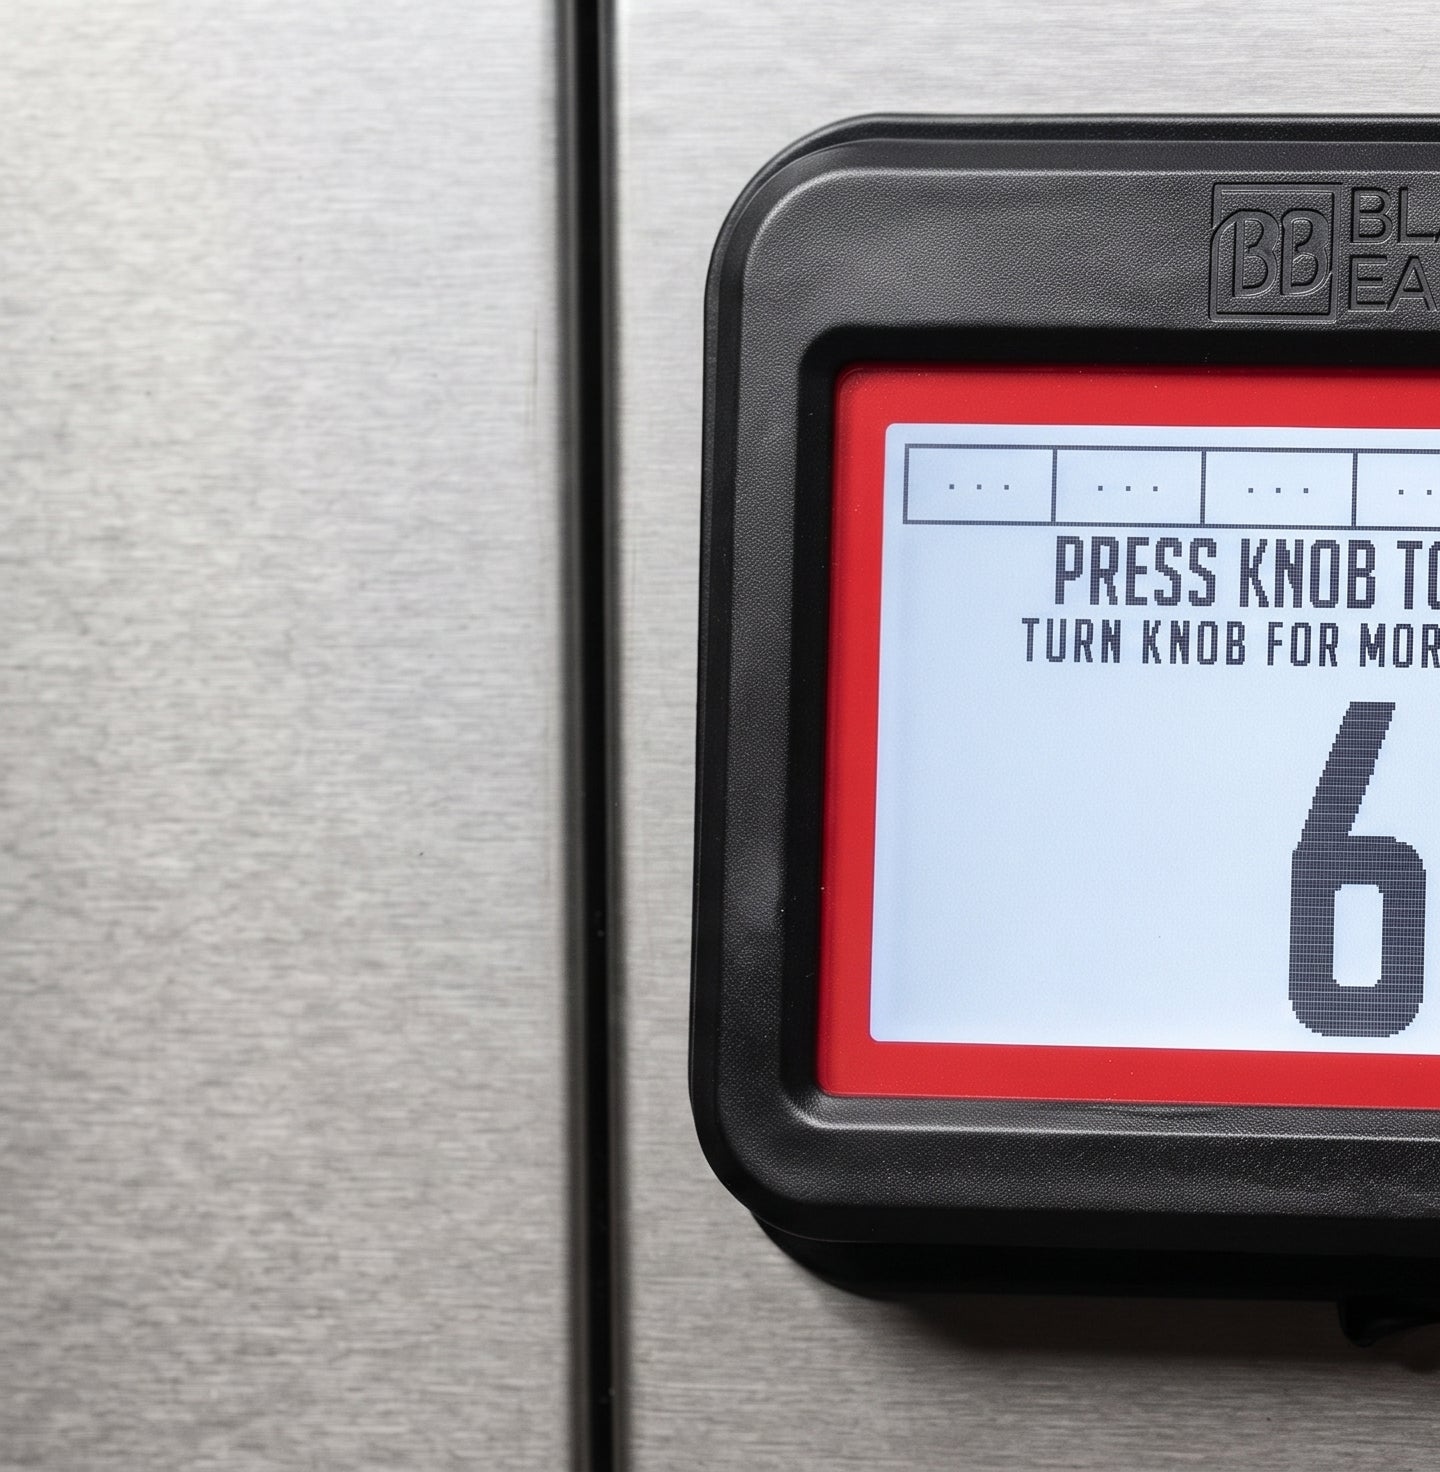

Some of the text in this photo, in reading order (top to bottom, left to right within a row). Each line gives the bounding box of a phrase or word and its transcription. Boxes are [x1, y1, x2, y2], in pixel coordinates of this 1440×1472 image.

[1055, 535, 1217, 606] PRESS
[1239, 538, 1376, 609] KNOB
[1021, 617, 1122, 664] TURN
[1142, 619, 1246, 666] KNOB
[1267, 621, 1339, 667] FOR
